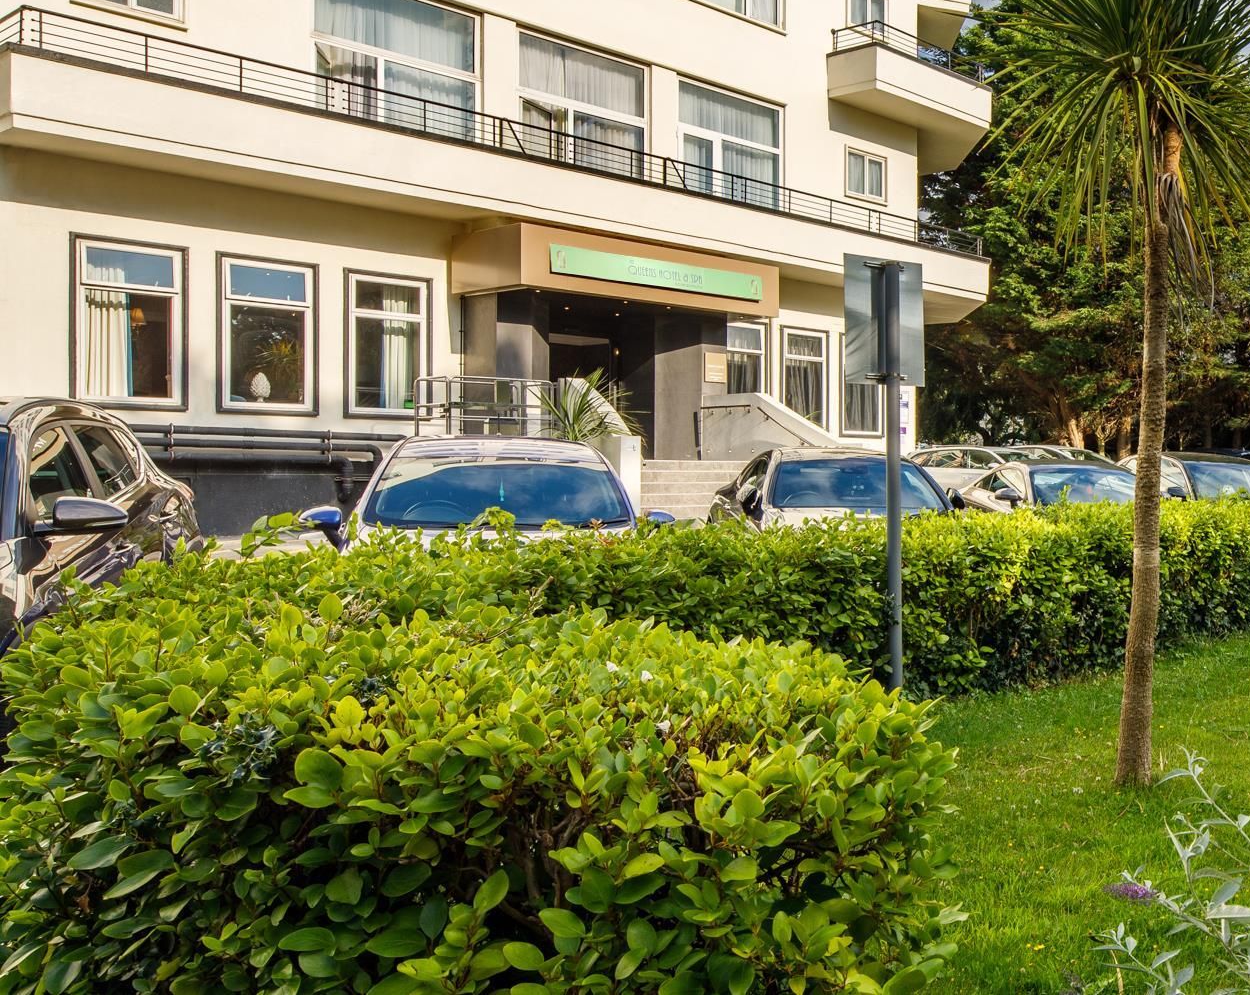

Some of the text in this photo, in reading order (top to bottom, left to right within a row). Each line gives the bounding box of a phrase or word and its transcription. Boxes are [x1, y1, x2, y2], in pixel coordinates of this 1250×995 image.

[627, 265, 657, 278] QUEENS
[658, 269, 681, 282] HOTEL
[690, 274, 703, 285] SPA
